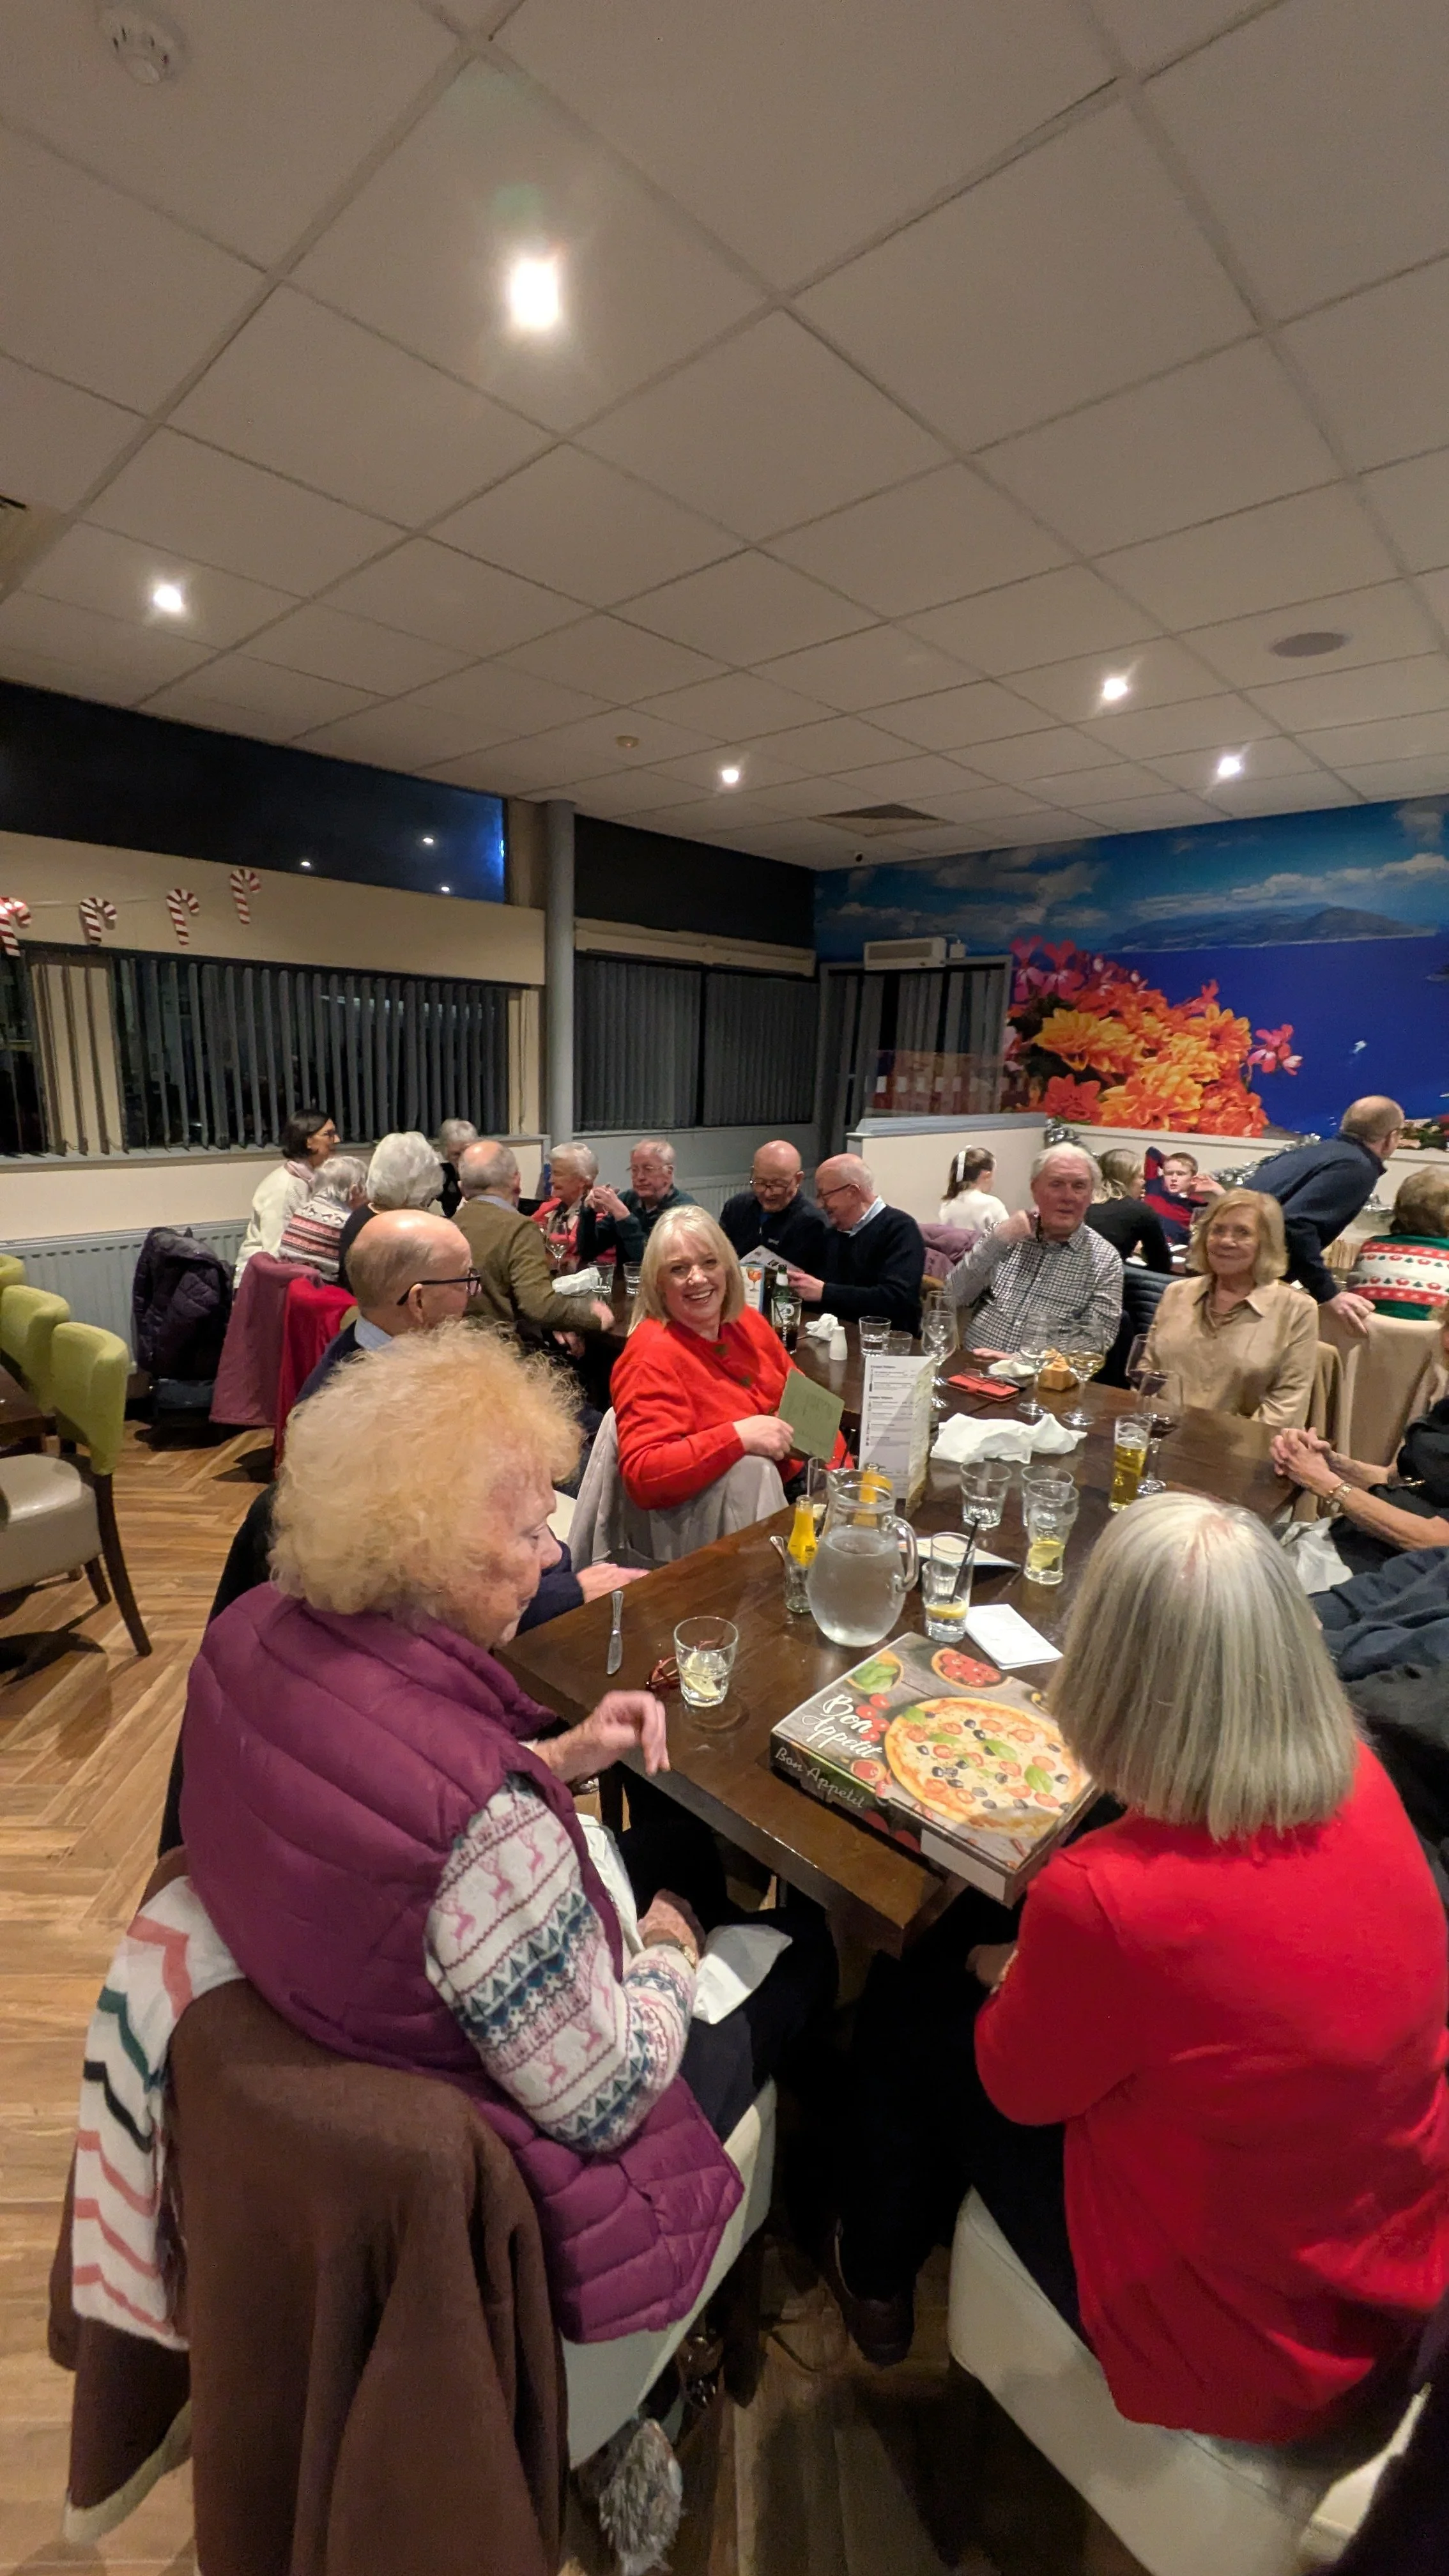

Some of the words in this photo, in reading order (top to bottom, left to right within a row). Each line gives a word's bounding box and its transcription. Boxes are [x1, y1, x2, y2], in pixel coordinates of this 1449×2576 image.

[820, 1694, 873, 1734] Bon
[802, 1715, 883, 1758] Appetit
[776, 1747, 804, 1772] Bon
[807, 1768, 865, 1808] Appetit
